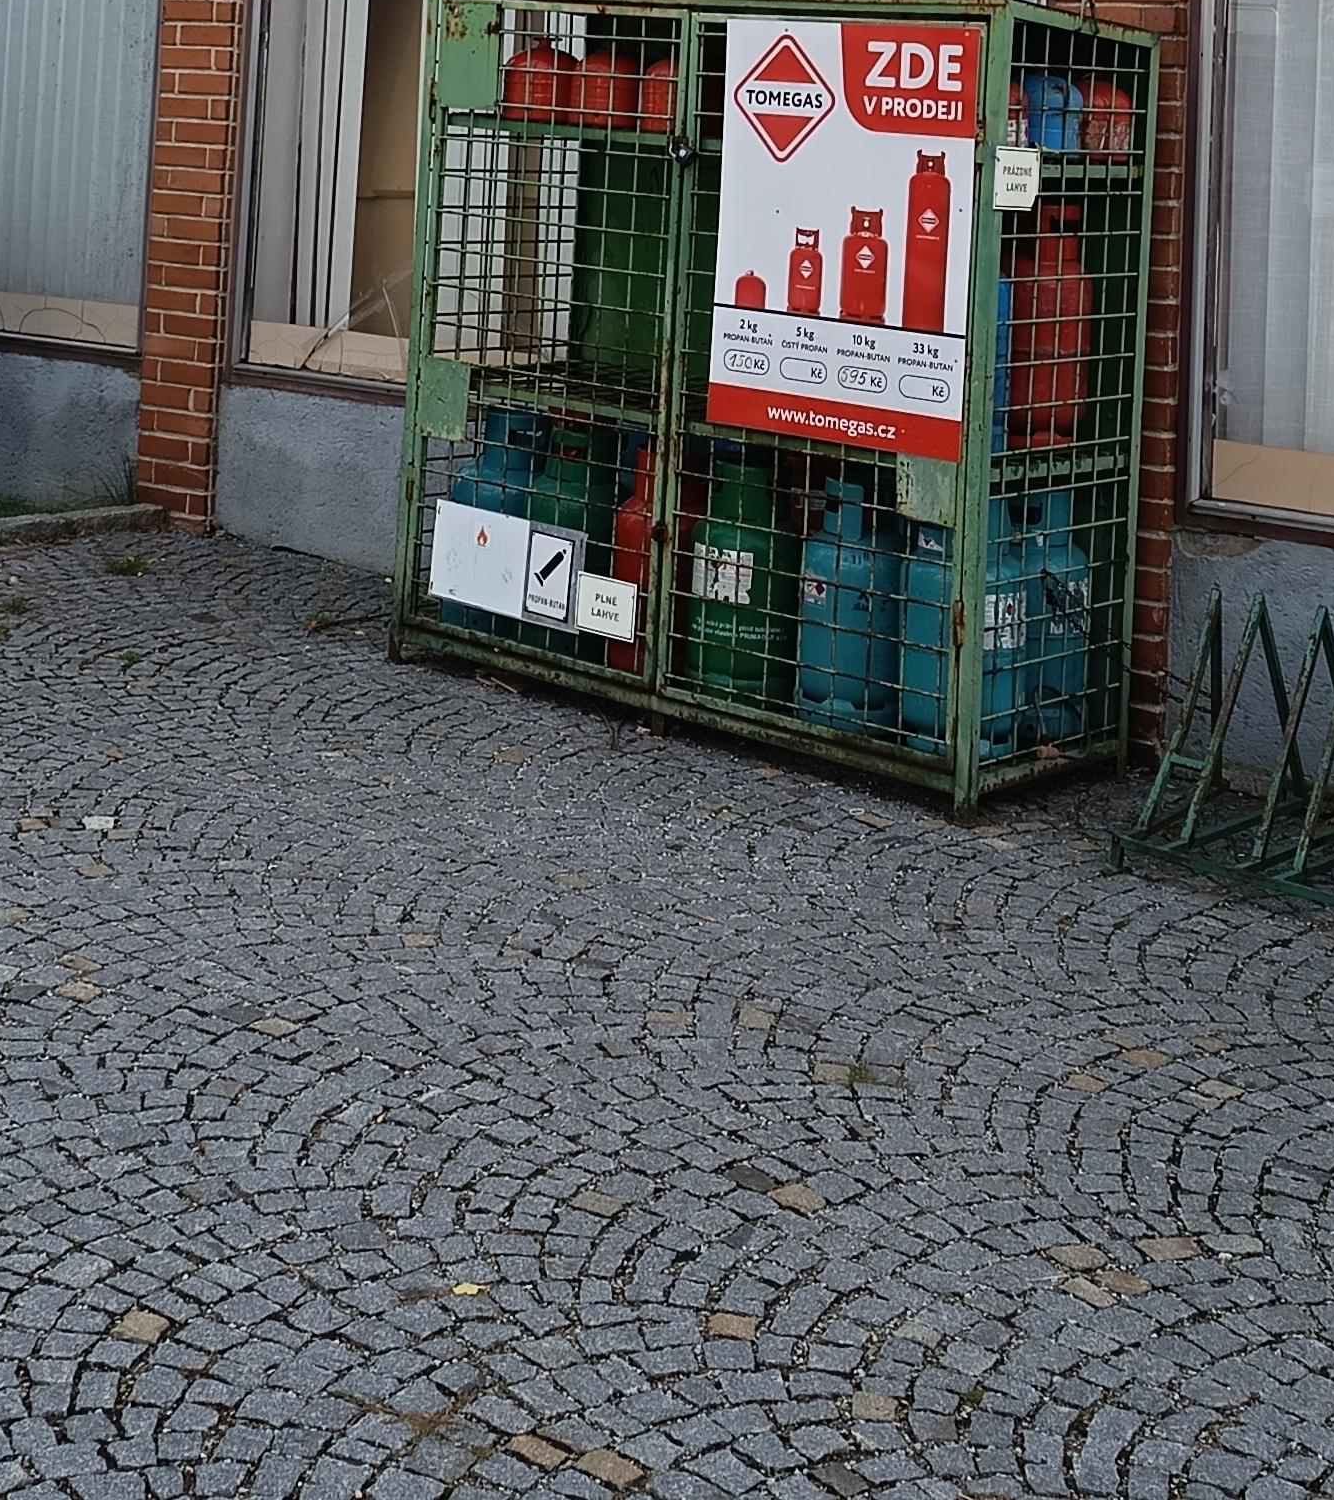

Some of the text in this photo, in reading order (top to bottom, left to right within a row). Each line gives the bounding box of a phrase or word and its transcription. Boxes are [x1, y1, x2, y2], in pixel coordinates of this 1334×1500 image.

[865, 41, 964, 92] ZDE
[746, 90, 823, 109] TOMEGAS
[863, 96, 963, 121] V PRODEJI
[739, 319, 758, 333] 2 kg
[796, 326, 815, 341] 5 kg
[723, 332, 773, 346] PROPAN-BUTAN
[781, 340, 828, 353] ČISTÝ PROPAN
[852, 334, 875, 350] 10 kg
[837, 348, 890, 363] PROPAN-BUTAN
[913, 342, 939, 358] 33 kg
[730, 353, 752, 369] 150
[754, 358, 765, 370] Kč
[898, 357, 953, 372] PROPAN-BUTAN
[810, 367, 822, 379] Kč
[841, 368, 868, 385] 595
[870, 376, 882, 388] Kč
[932, 385, 944, 397] Kč
[767, 407, 896, 439] www.tomegas.cz
[595, 593, 617, 606] PLNÉ
[591, 607, 619, 622] LAHVE
